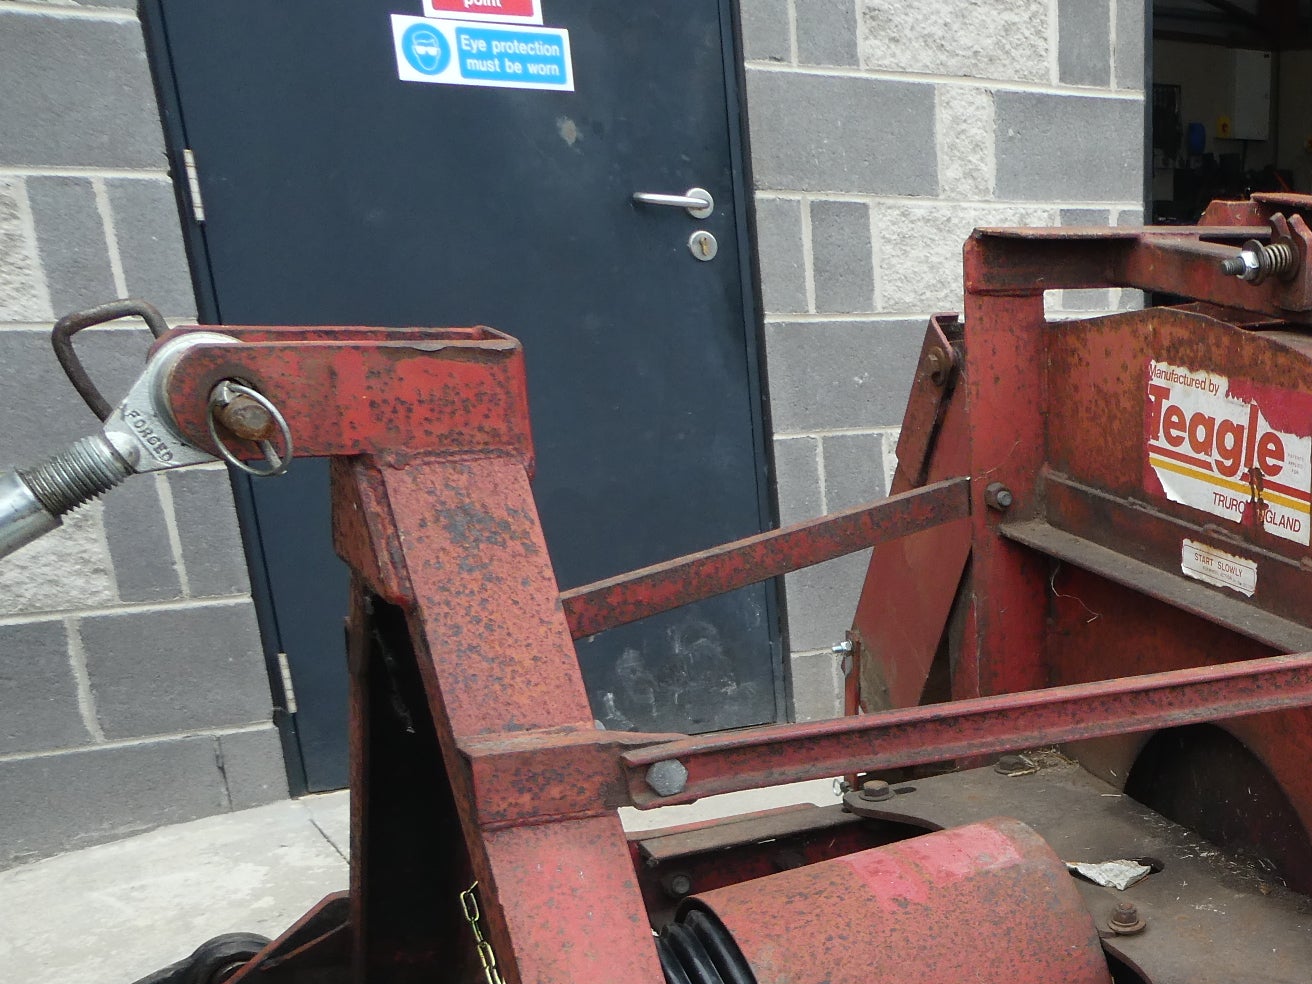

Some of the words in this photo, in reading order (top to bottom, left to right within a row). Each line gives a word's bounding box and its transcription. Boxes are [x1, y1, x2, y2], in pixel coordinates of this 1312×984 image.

[461, 34, 487, 53] Eye
[492, 39, 560, 56] protection
[467, 60, 500, 73] must
[505, 59, 522, 74] be
[528, 64, 560, 76] worn
[1149, 364, 1207, 391] Manufactured
[1208, 379, 1220, 397] by
[126, 410, 174, 463] FORGED
[1149, 383, 1285, 478] Teagle
[1212, 491, 1246, 515] TRURO
[1194, 552, 1213, 567] START
[1217, 561, 1243, 578] SLOWLY
